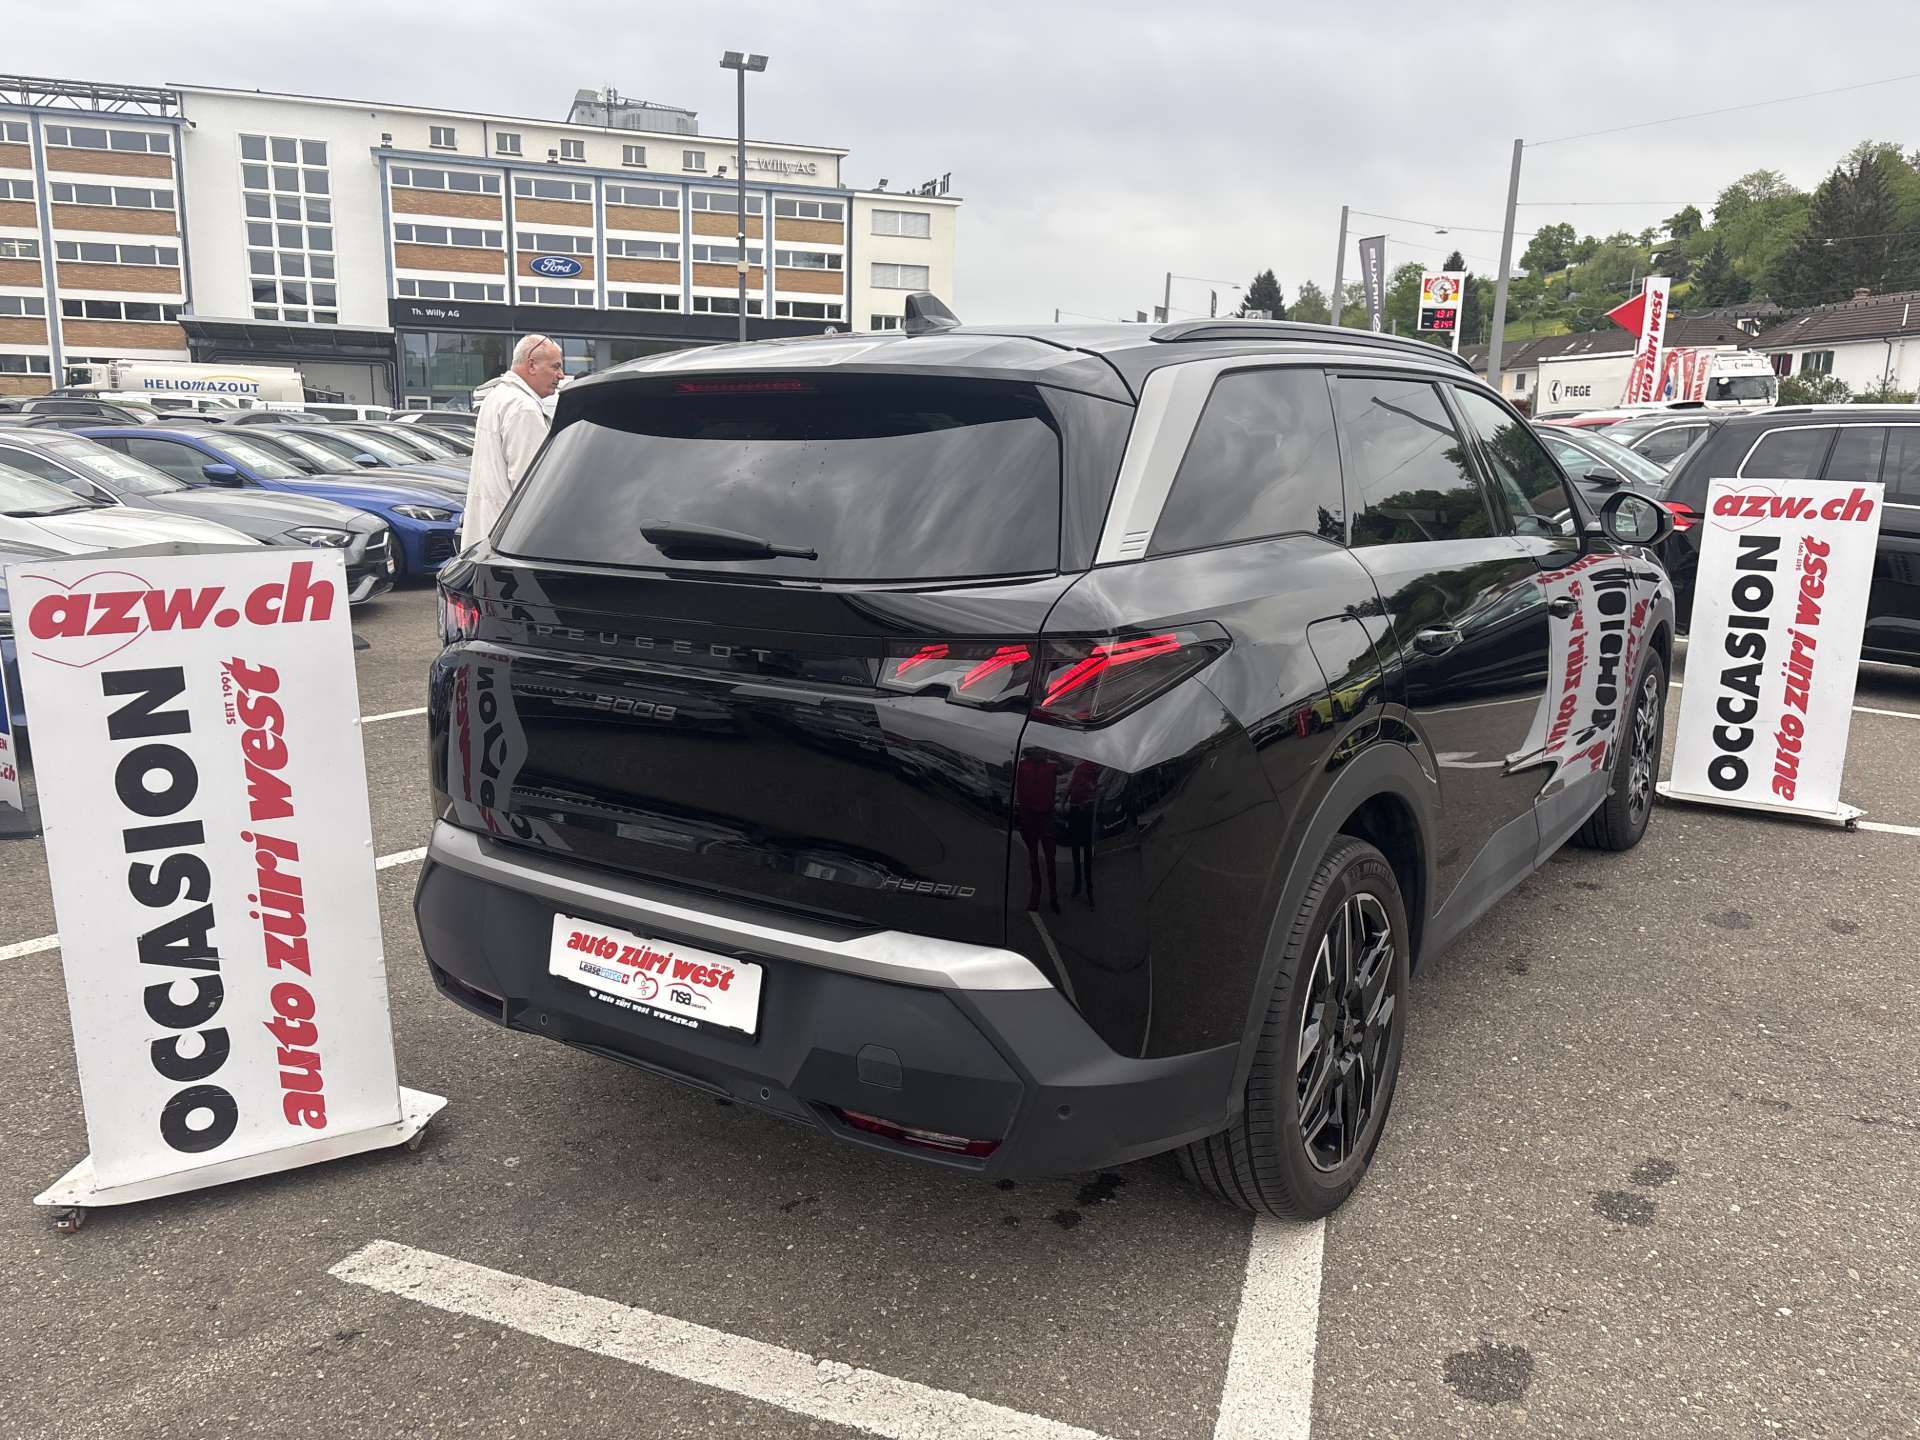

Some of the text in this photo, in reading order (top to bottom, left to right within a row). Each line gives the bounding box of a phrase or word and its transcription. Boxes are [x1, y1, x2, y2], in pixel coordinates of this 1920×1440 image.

[758, 158, 794, 176] Willy
[796, 160, 817, 175] AG
[540, 258, 574, 273] Ford
[425, 308, 446, 318] Willy
[447, 310, 460, 318] AG
[1650, 289, 1664, 332] west
[1565, 385, 1592, 397] FIEGE
[1712, 488, 1875, 522] azw.ch
[29, 561, 334, 640] azw.ch
[535, 625, 772, 663] PEUGEOT
[1708, 535, 1781, 792] OCCASION
[1772, 535, 1830, 801] auto züri west
[220, 671, 236, 725] SEIT 1991
[595, 694, 678, 721] 5008
[220, 656, 326, 1129] auto züri west
[882, 876, 977, 898] HYBRID
[101, 665, 239, 1154] OCCASION
[566, 931, 736, 992] auto züri west
[598, 993, 616, 1004] auto
[615, 998, 632, 1010] züri
[632, 1003, 651, 1015] west
[670, 989, 692, 1006] nsa
